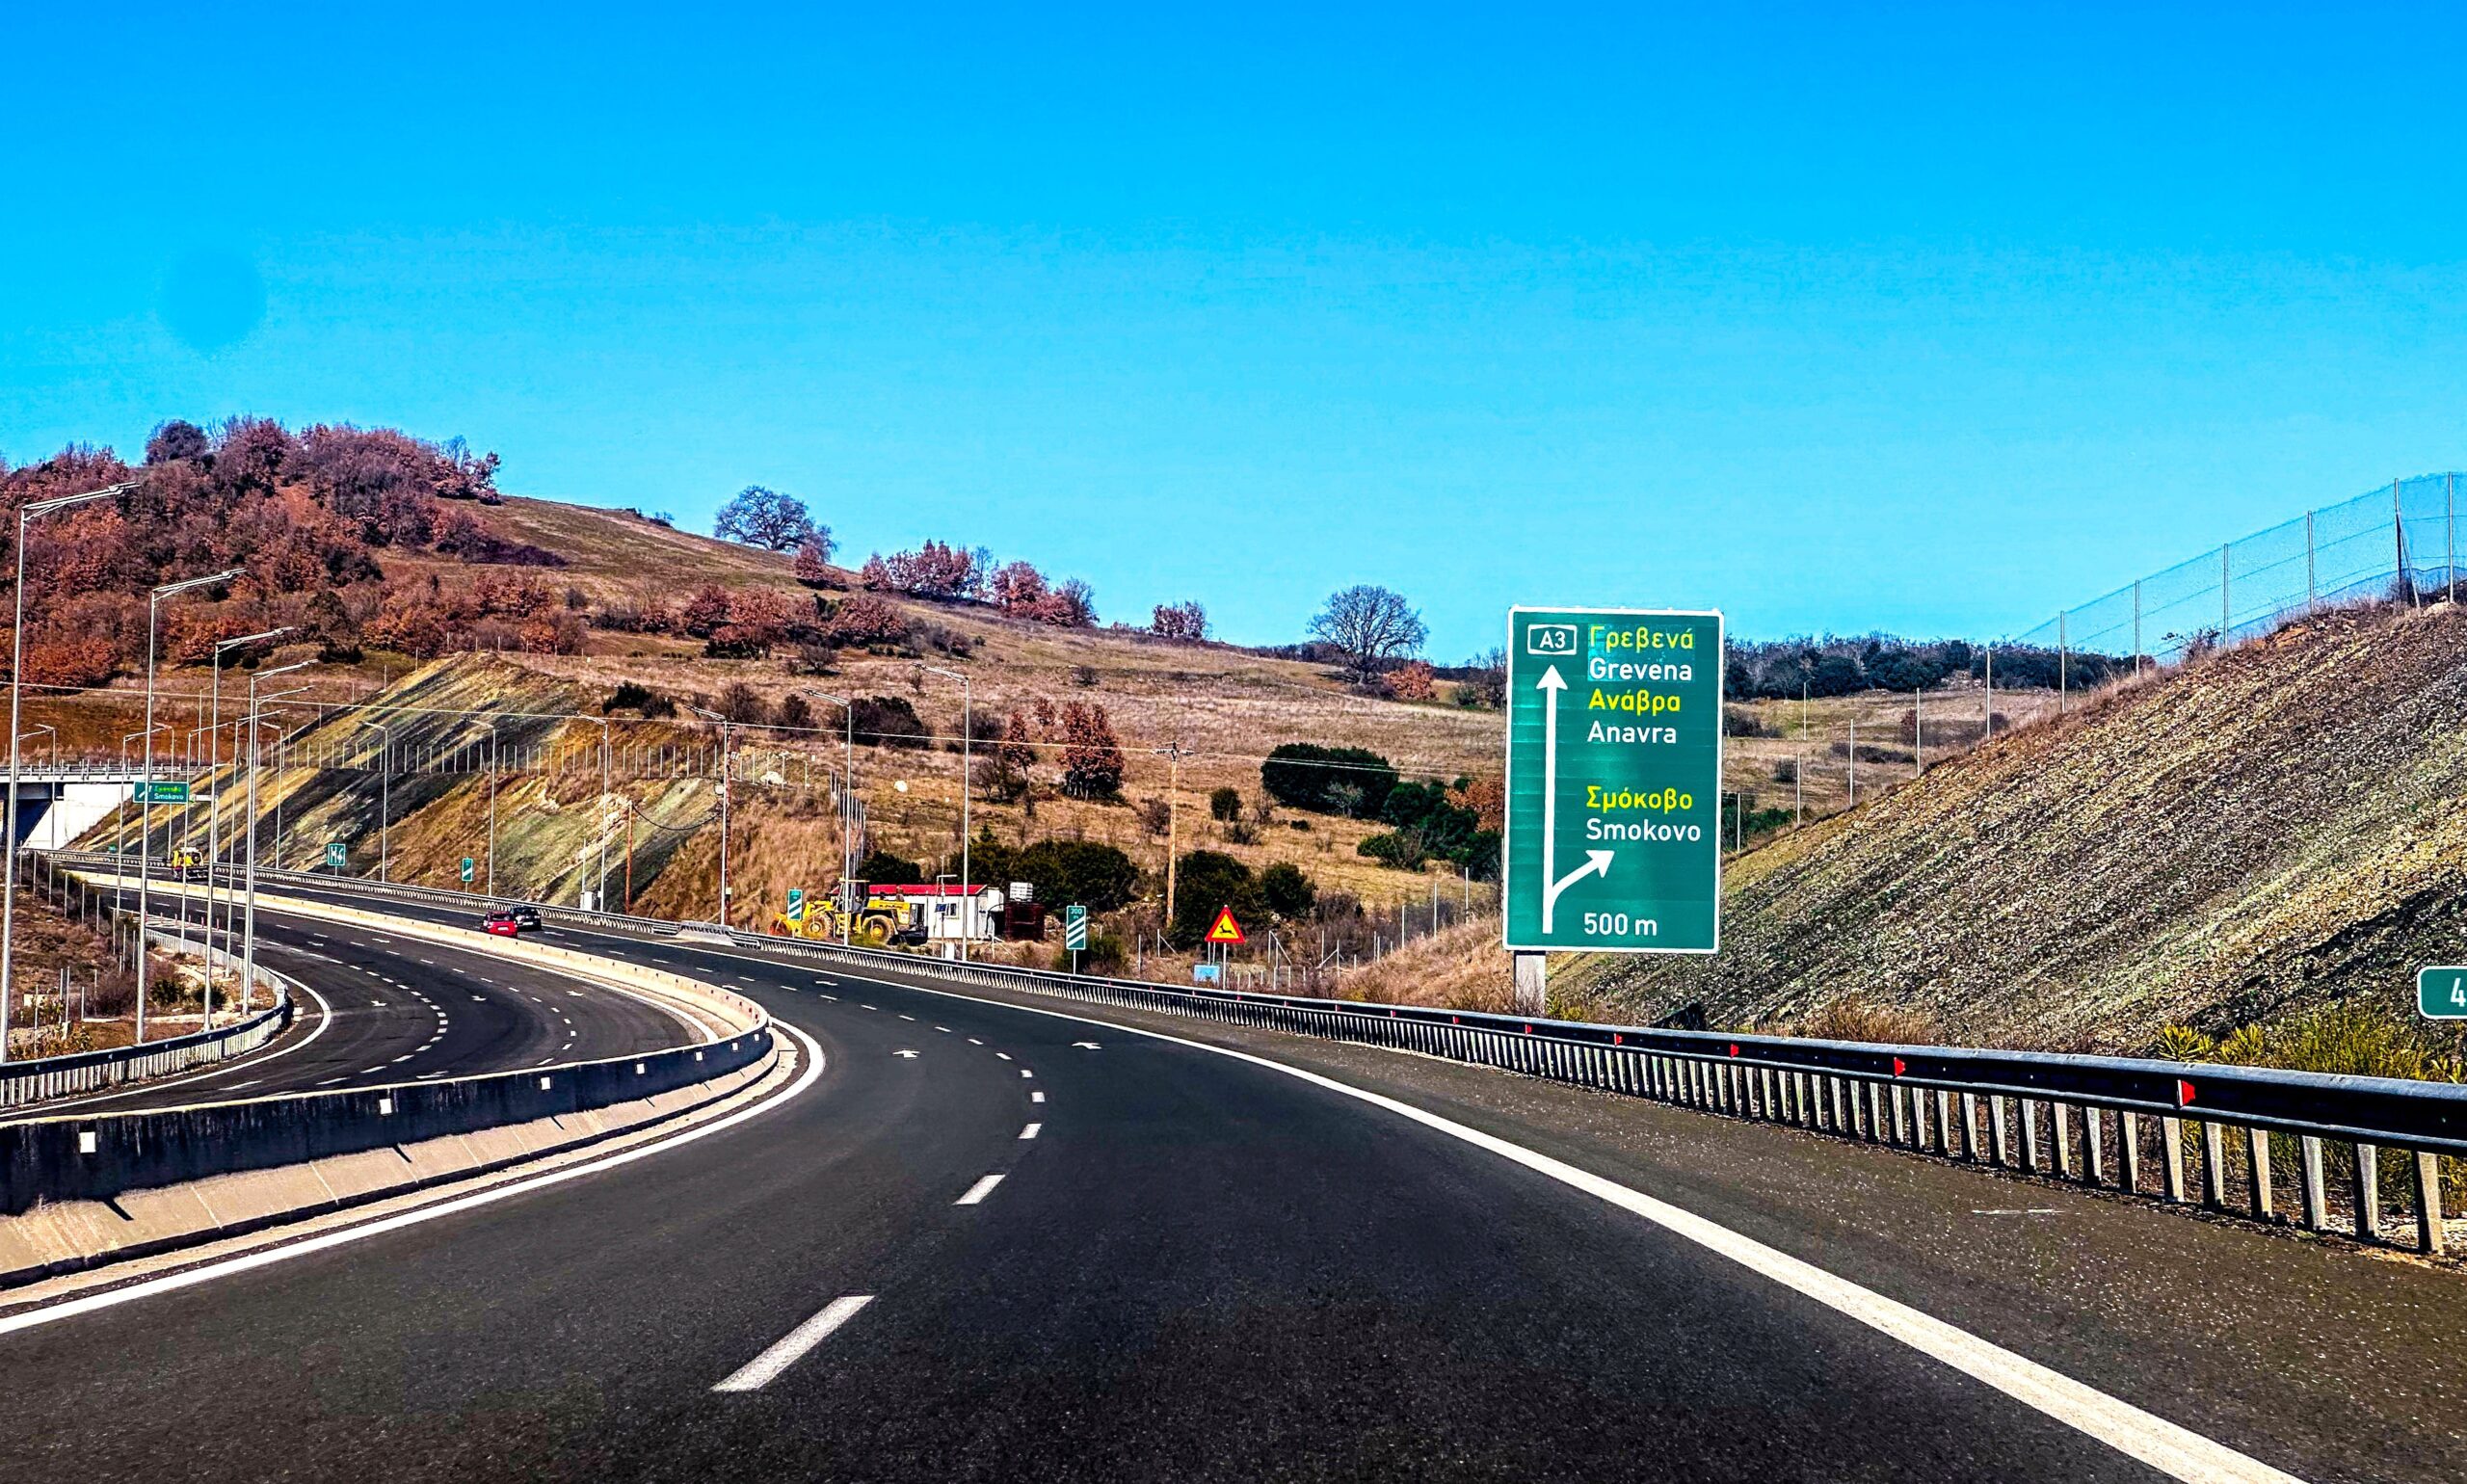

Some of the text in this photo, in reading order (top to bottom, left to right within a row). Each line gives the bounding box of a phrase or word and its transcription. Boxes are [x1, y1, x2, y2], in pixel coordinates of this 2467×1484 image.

[1539, 629, 1566, 649] A3
[1589, 624, 1694, 653] Γρεβενά
[1589, 657, 1693, 681] Grevena
[1588, 688, 1681, 716] Ανάβρα
[1587, 721, 1677, 744] Anavra
[1586, 784, 1693, 814] Σμόκοβο
[1586, 818, 1701, 842] Smokovo
[1583, 913, 1658, 937] 500 m
[2450, 977, 2467, 1008] 4
